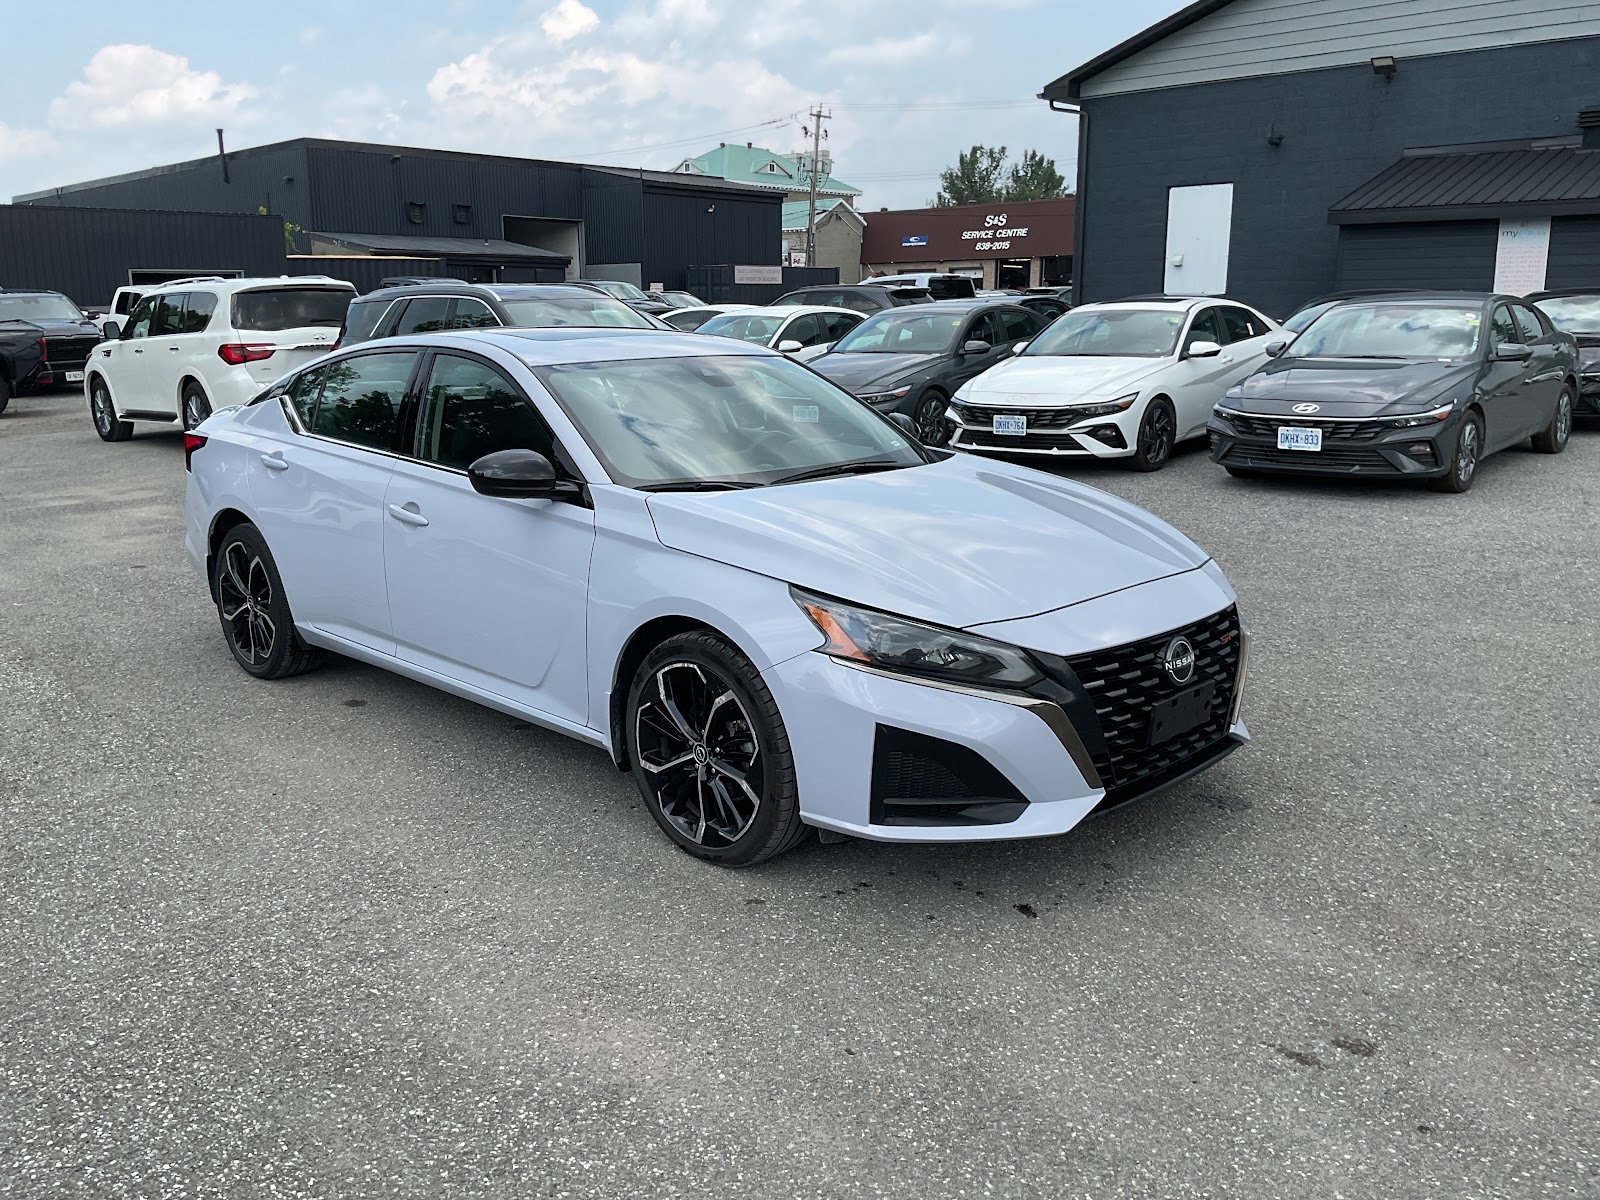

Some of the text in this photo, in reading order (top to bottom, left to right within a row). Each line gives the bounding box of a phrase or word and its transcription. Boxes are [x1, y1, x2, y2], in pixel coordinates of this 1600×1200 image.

[984, 213, 1007, 227] S&S
[961, 228, 1028, 239] SERVICE CENTRE
[975, 241, 1010, 250] 838-2015
[1165, 652, 1195, 670] NISSAN
